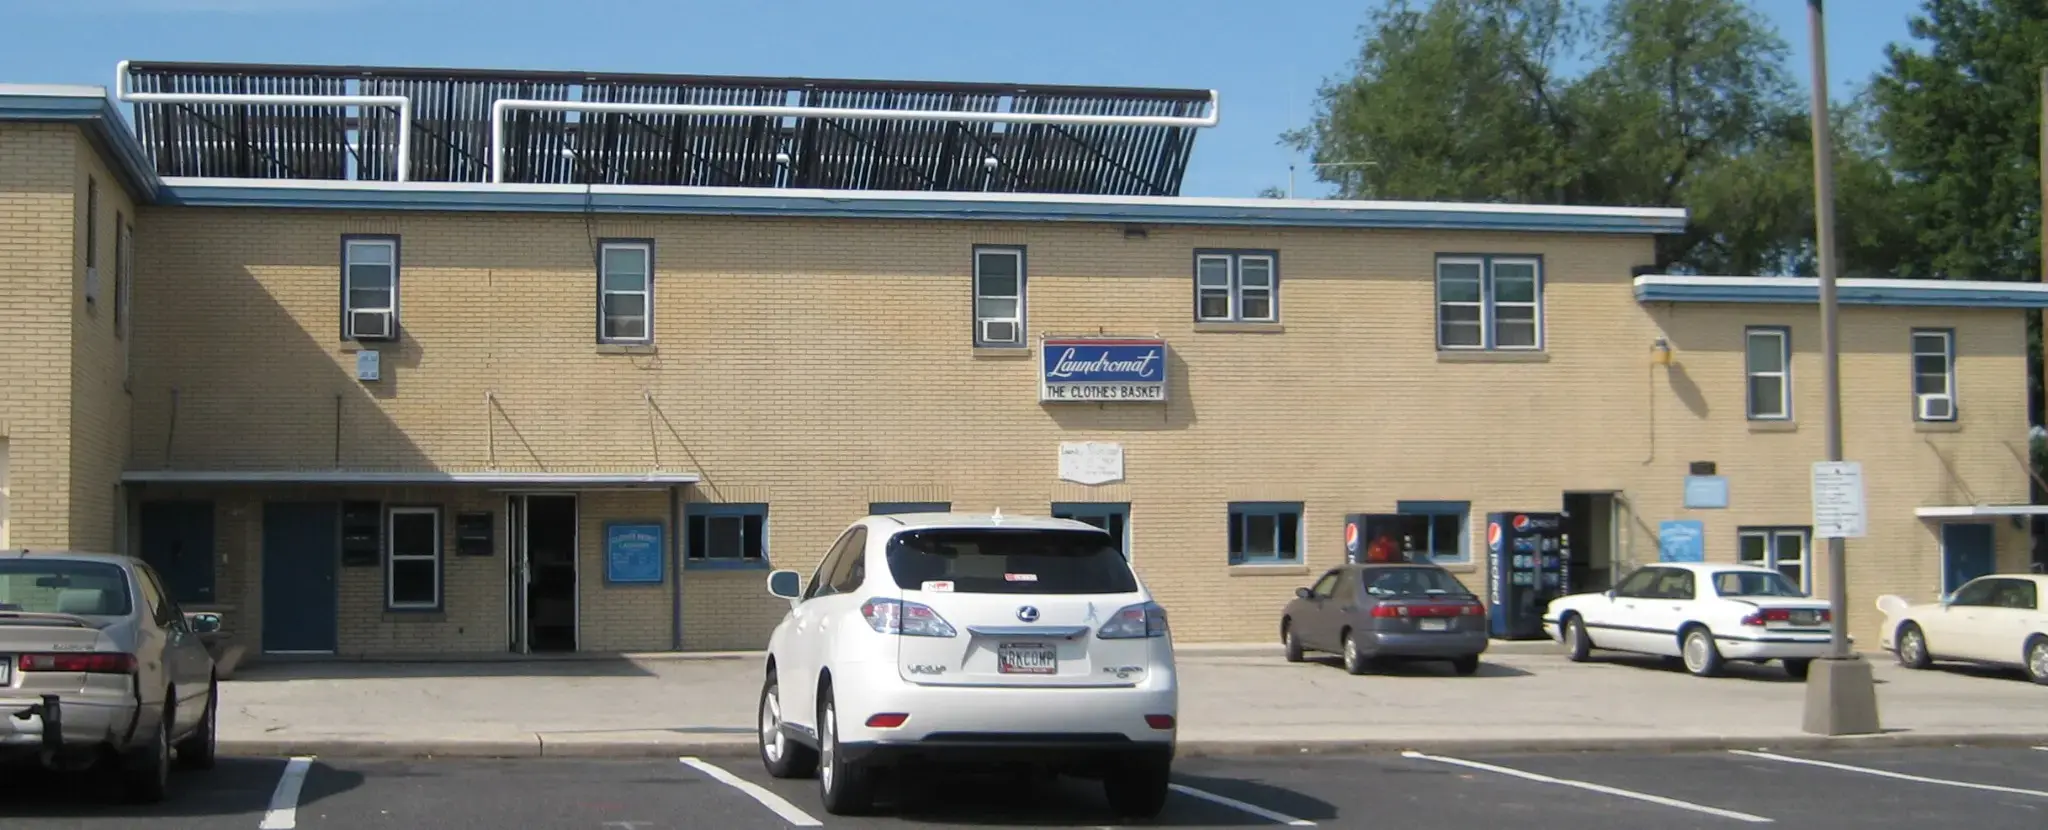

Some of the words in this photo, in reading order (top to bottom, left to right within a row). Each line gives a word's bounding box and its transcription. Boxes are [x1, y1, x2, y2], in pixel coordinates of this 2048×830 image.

[1047, 348, 1160, 378] Laundromat
[1047, 385, 1066, 398] THE
[1070, 385, 1117, 398] CLOTHES
[1121, 385, 1160, 398] BASKET
